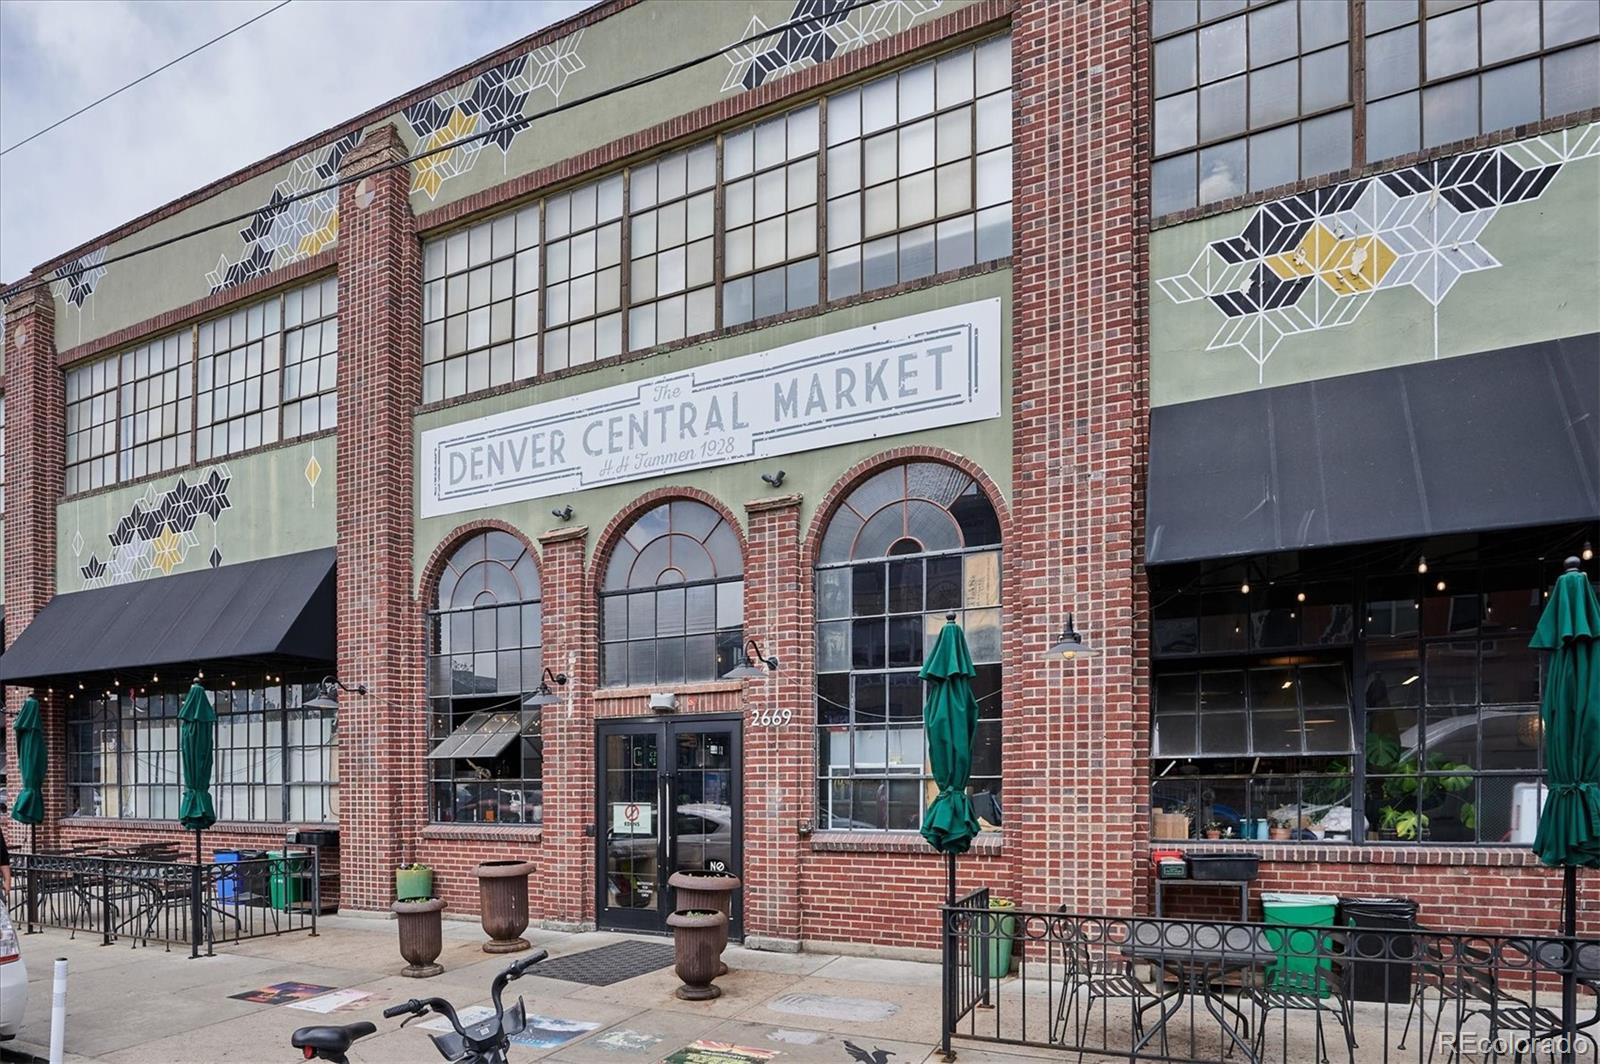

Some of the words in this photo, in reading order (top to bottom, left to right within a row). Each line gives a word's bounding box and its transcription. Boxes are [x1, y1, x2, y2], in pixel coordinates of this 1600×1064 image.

[652, 384, 681, 402] The
[449, 429, 565, 486] DENVER
[582, 391, 750, 457] CENTRAL
[773, 345, 953, 422] MARKET
[634, 448, 696, 470] Tammen
[700, 436, 735, 458] 1928
[751, 708, 792, 726] 2669
